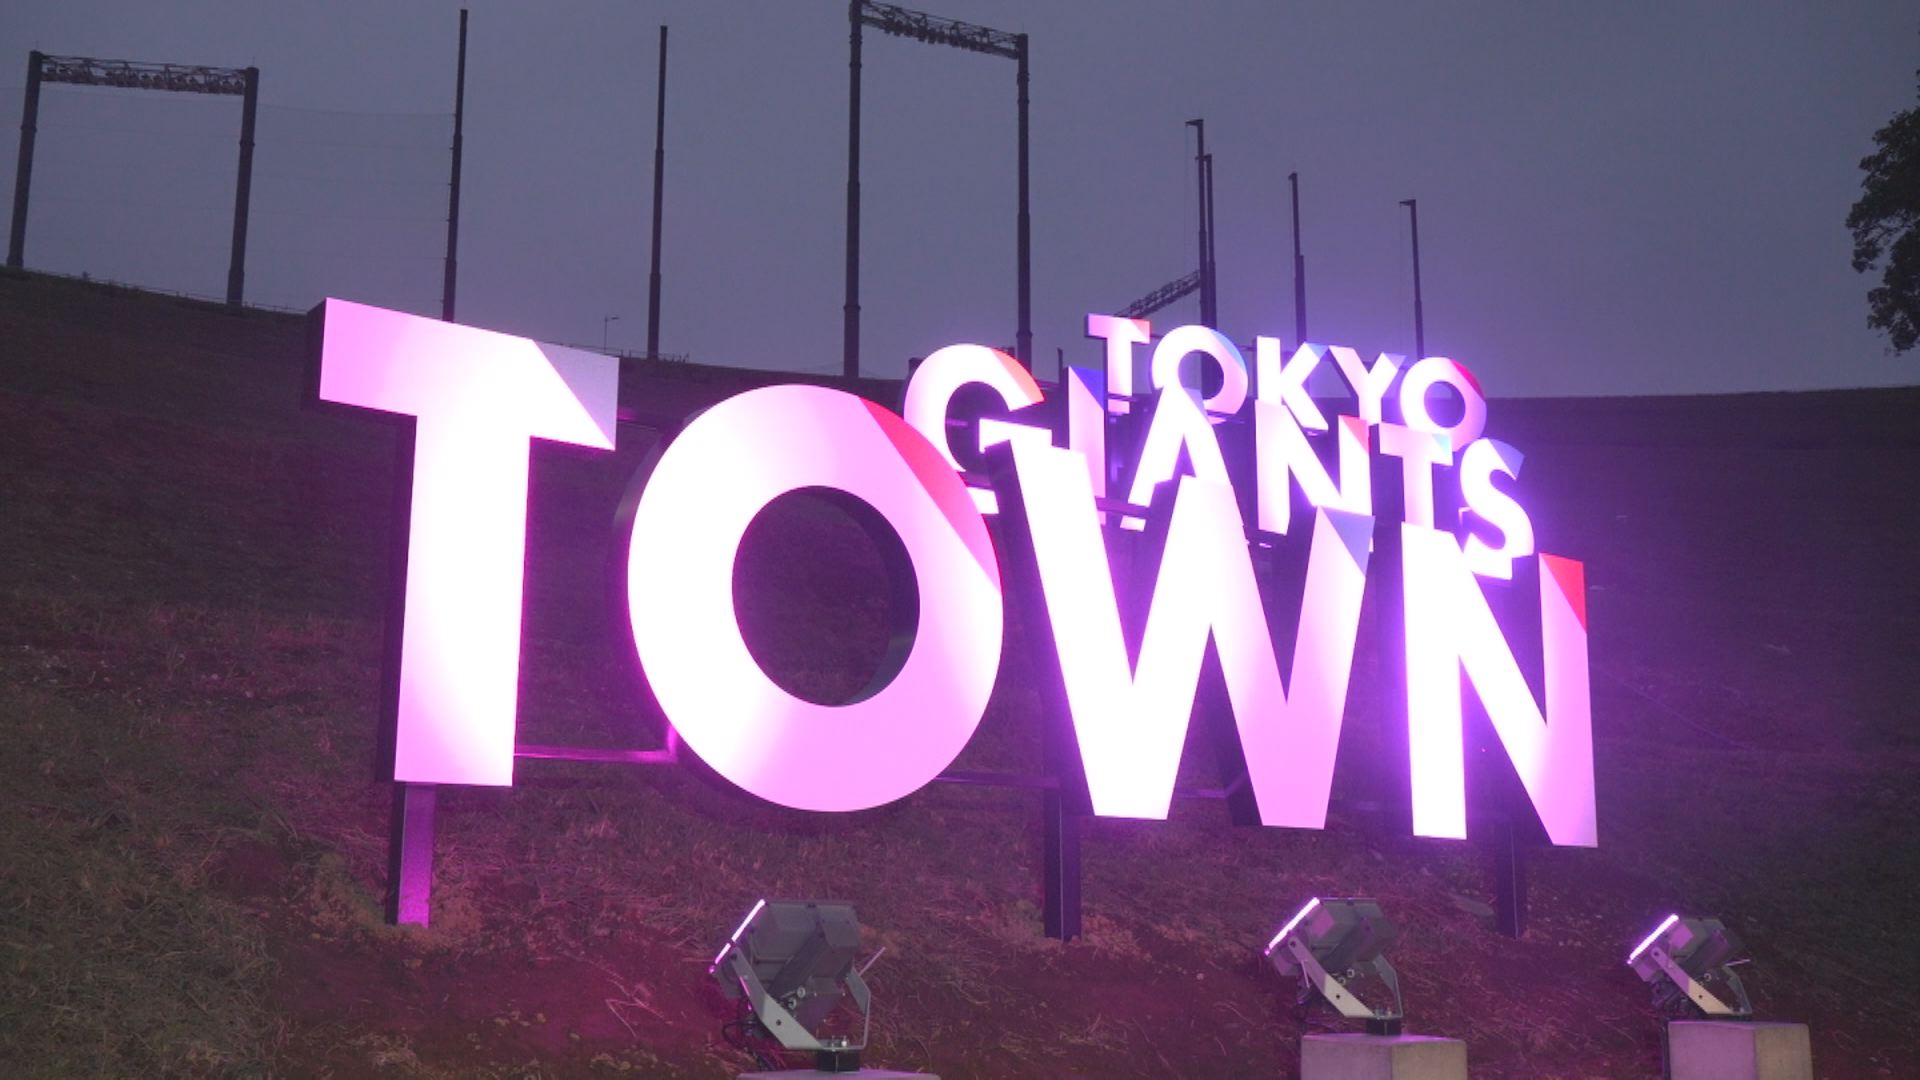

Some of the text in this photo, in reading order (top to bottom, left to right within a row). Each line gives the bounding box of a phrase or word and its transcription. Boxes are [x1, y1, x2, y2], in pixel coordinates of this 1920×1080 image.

[904, 343, 1535, 578] GIANTS
[1088, 313, 1487, 452] TOKYO
[319, 297, 1598, 848] TOWN
